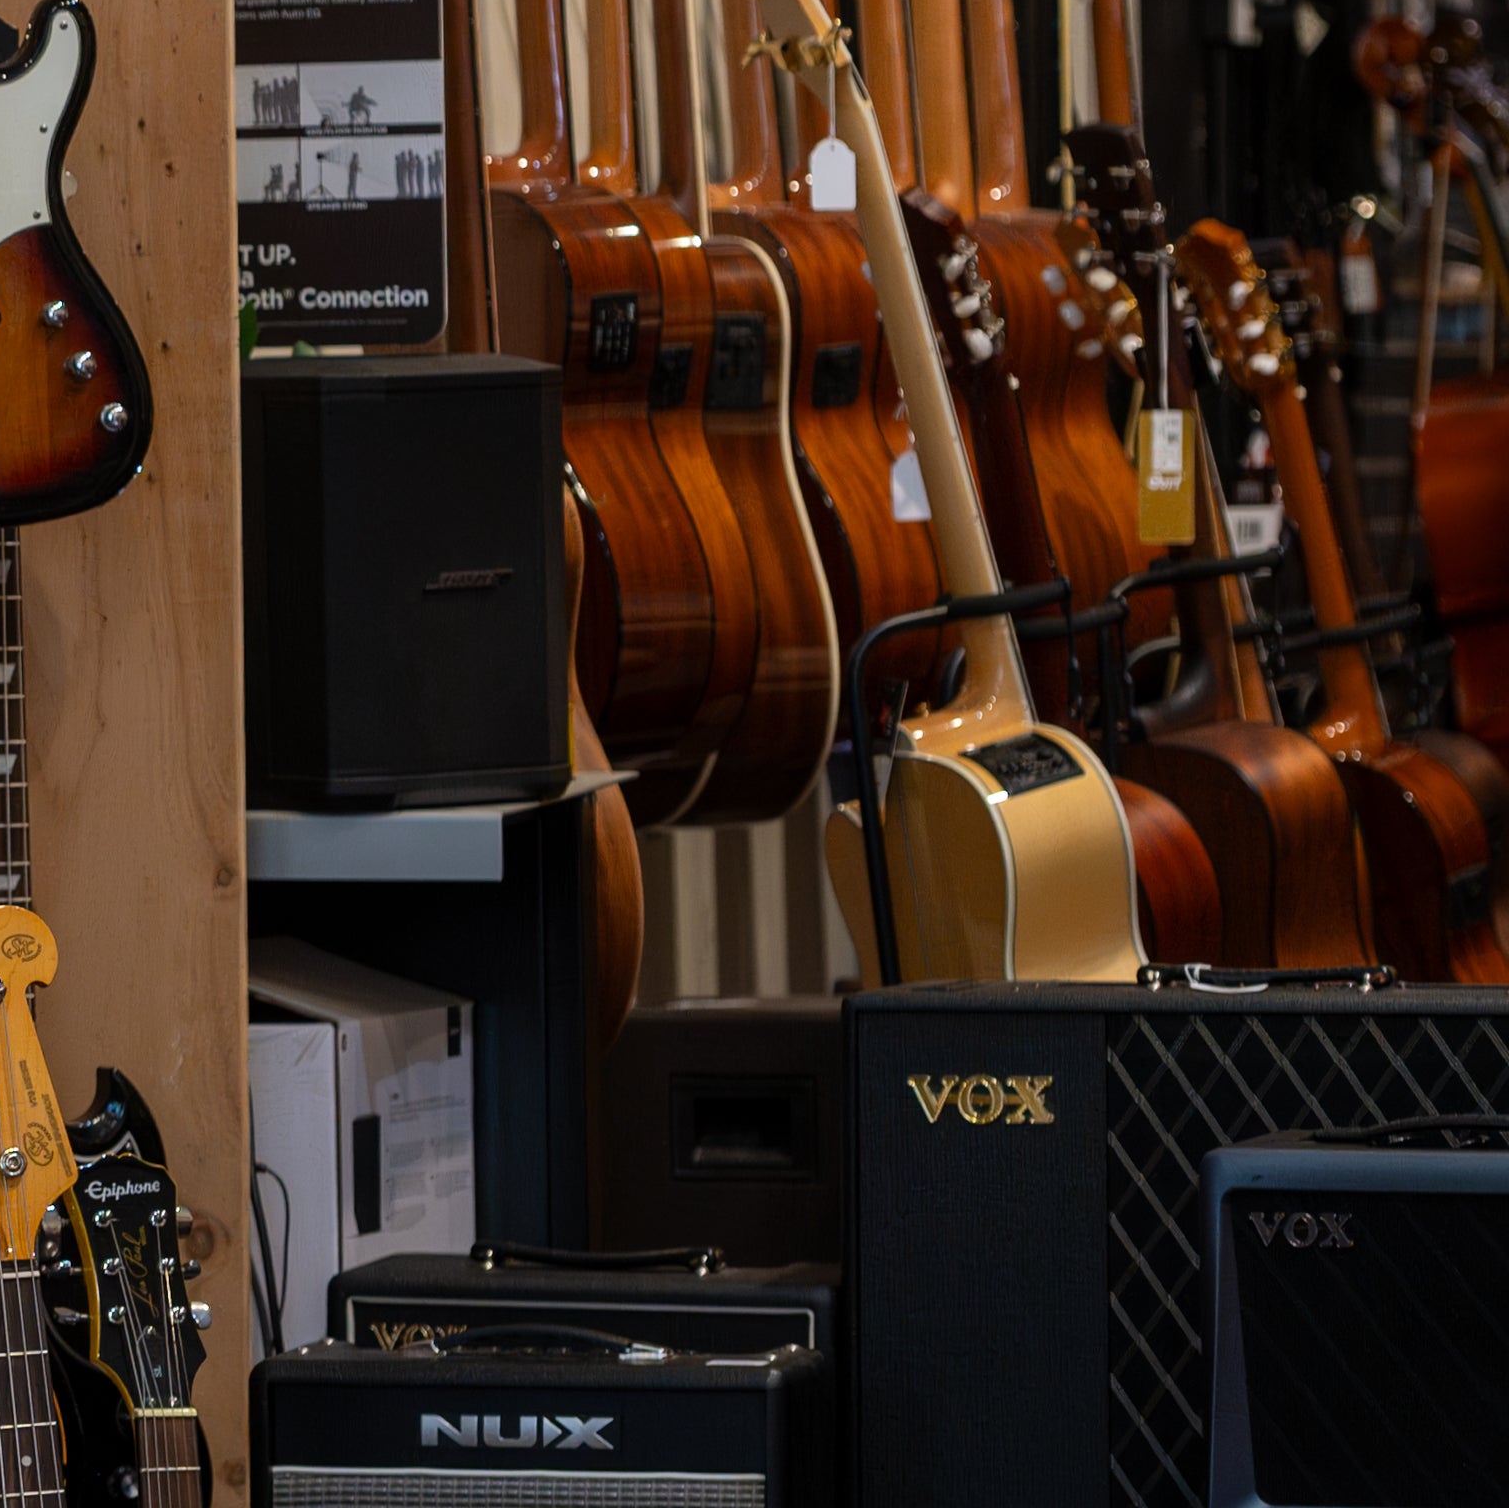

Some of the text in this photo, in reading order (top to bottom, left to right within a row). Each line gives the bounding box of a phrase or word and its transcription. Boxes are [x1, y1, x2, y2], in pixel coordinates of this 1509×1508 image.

[257, 244, 297, 266] UP.
[298, 284, 430, 310] Connection
[907, 1074, 1055, 1125] VOX
[84, 1179, 161, 1203] Epiphone
[1249, 1211, 1354, 1249] VOX
[121, 1231, 148, 1279] Paul
[420, 1413, 615, 1450] NUX
